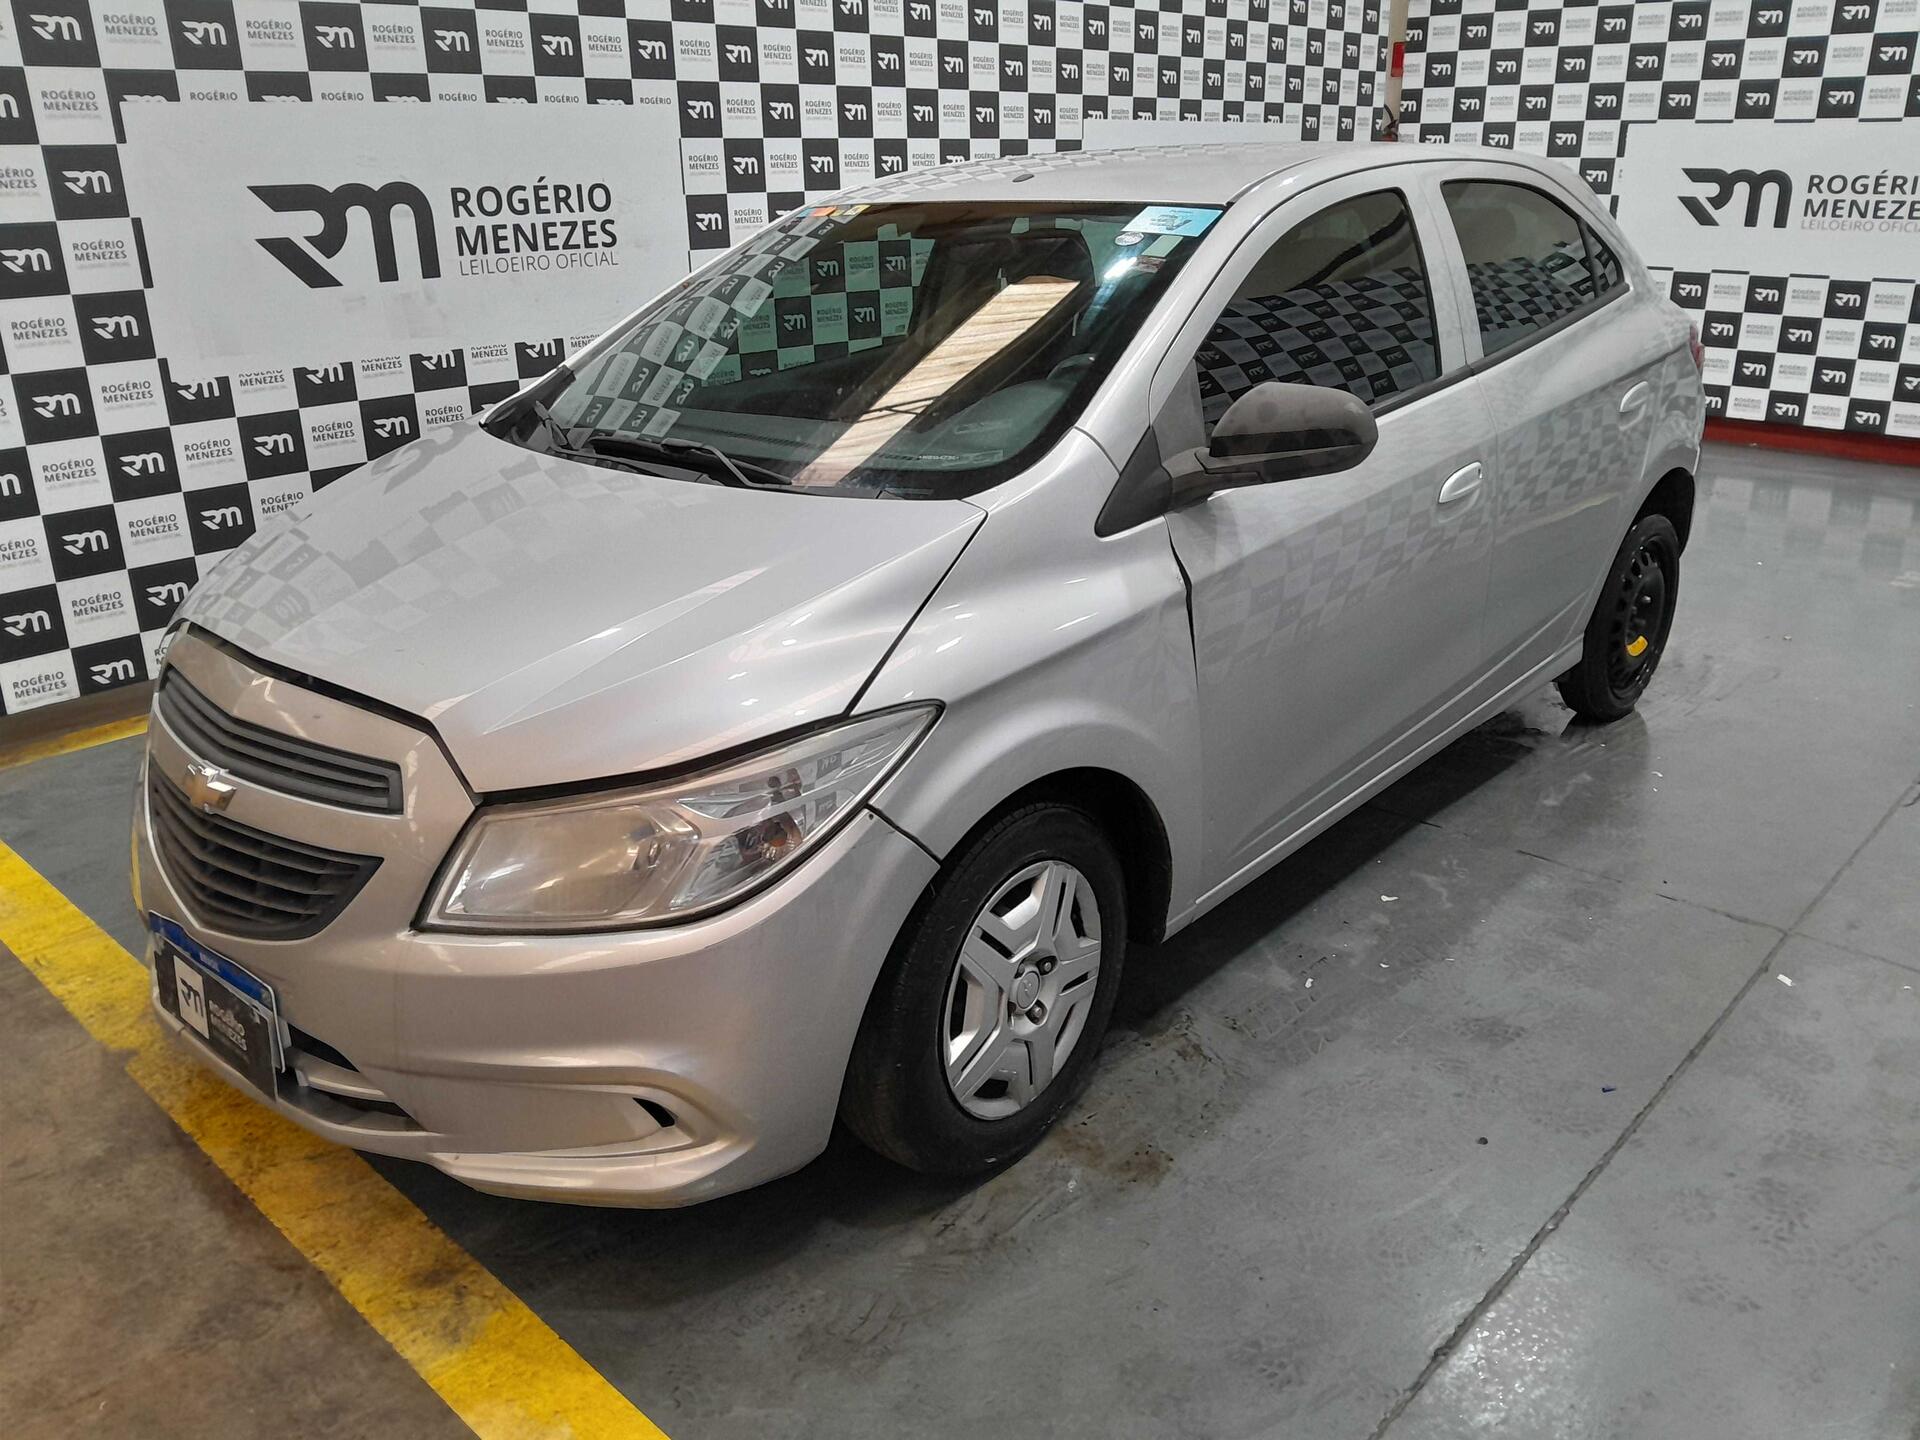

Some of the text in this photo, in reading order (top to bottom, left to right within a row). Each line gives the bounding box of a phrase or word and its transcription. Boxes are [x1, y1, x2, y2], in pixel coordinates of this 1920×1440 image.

[874, 4, 899, 13] MENEZES
[103, 15, 155, 25] ROGÉRIO
[246, 21, 292, 30] ROGÉRIO
[372, 25, 413, 34] ROGÉRIO
[105, 26, 158, 36] MENEZES
[248, 31, 294, 40] MENEZES
[485, 30, 522, 39] ROGÉRIO
[374, 35, 415, 43] MENEZES
[487, 39, 524, 48] MENEZES
[588, 35, 621, 43] ROGÉRIO
[680, 40, 710, 48] ROGÉRIO
[589, 44, 622, 52] MENEZES
[681, 48, 711, 56] MENEZES
[763, 44, 791, 53] ROGÉRIO
[840, 48, 866, 57] ROGÉRIO
[763, 52, 792, 61] MENEZES
[840, 56, 866, 64] MENEZES
[909, 51, 933, 60] ROGÉRIO
[909, 58, 934, 68] MENEZES
[41, 91, 95, 100] ROGÉRIO
[190, 92, 238, 101] ROGÉRIO
[321, 92, 364, 101] ROGÉRIO
[439, 93, 477, 102] ROGÉRIO
[545, 95, 579, 103] ROGÉRIO
[44, 102, 98, 111] MENEZES
[805, 100, 832, 109] ROGÉRIO
[877, 102, 901, 111] ROGÉRIO
[726, 106, 756, 115] MENEZES
[805, 108, 832, 116] MENEZES
[877, 110, 902, 118] MENEZES
[689, 154, 719, 164] ROGÉRIO
[770, 153, 797, 162] ROGÉRIO
[844, 152, 869, 161] ROGÉRIO
[689, 162, 720, 171] MENEZES
[770, 160, 798, 170] MENEZES
[844, 160, 870, 168] MENEZES
[0, 179, 38, 189] NEZES
[1807, 169, 1920, 195] ROGÉRI
[450, 176, 612, 218] ROGÉRIO
[1803, 199, 1920, 220] MENEZE
[734, 216, 763, 225] MENEZES
[1800, 220, 1920, 233] LEILOEIRO OFICI
[455, 219, 617, 256] MENEZES
[72, 240, 124, 251] ROGÉRIO
[75, 250, 127, 261] MENEZES
[459, 251, 619, 276] LEILOEIRO OFICIAL
[11, 318, 65, 330] ROGÉRIO
[13, 328, 67, 340] MENEZES
[472, 348, 508, 358] MENEZES
[362, 361, 402, 372] MENEZES
[240, 374, 285, 386] MENEZES
[101, 381, 151, 393] ROGÉRIO
[103, 390, 153, 403] MENEZES
[425, 405, 463, 416] ROGÉRIO
[425, 415, 465, 425] MENEZES
[311, 421, 353, 433] ROGÉRIO
[313, 429, 355, 442] MENEZES
[184, 439, 230, 452] ROGÉRIO
[186, 448, 232, 461] MENEZES
[42, 458, 94, 473] ROGÉRIO
[45, 468, 96, 482] MENEZES
[261, 492, 303, 505] ROGÉRIO
[129, 514, 176, 528] ROGÉRIO
[131, 523, 179, 537] MENEZES
[0, 539, 36, 552] GÉRIO
[0, 547, 39, 561] NEZES
[72, 592, 121, 608] ROGÉRIO
[73, 600, 124, 616] MENEZES
[13, 672, 64, 689] ROGÉRIO
[15, 680, 67, 698] MENEZES
